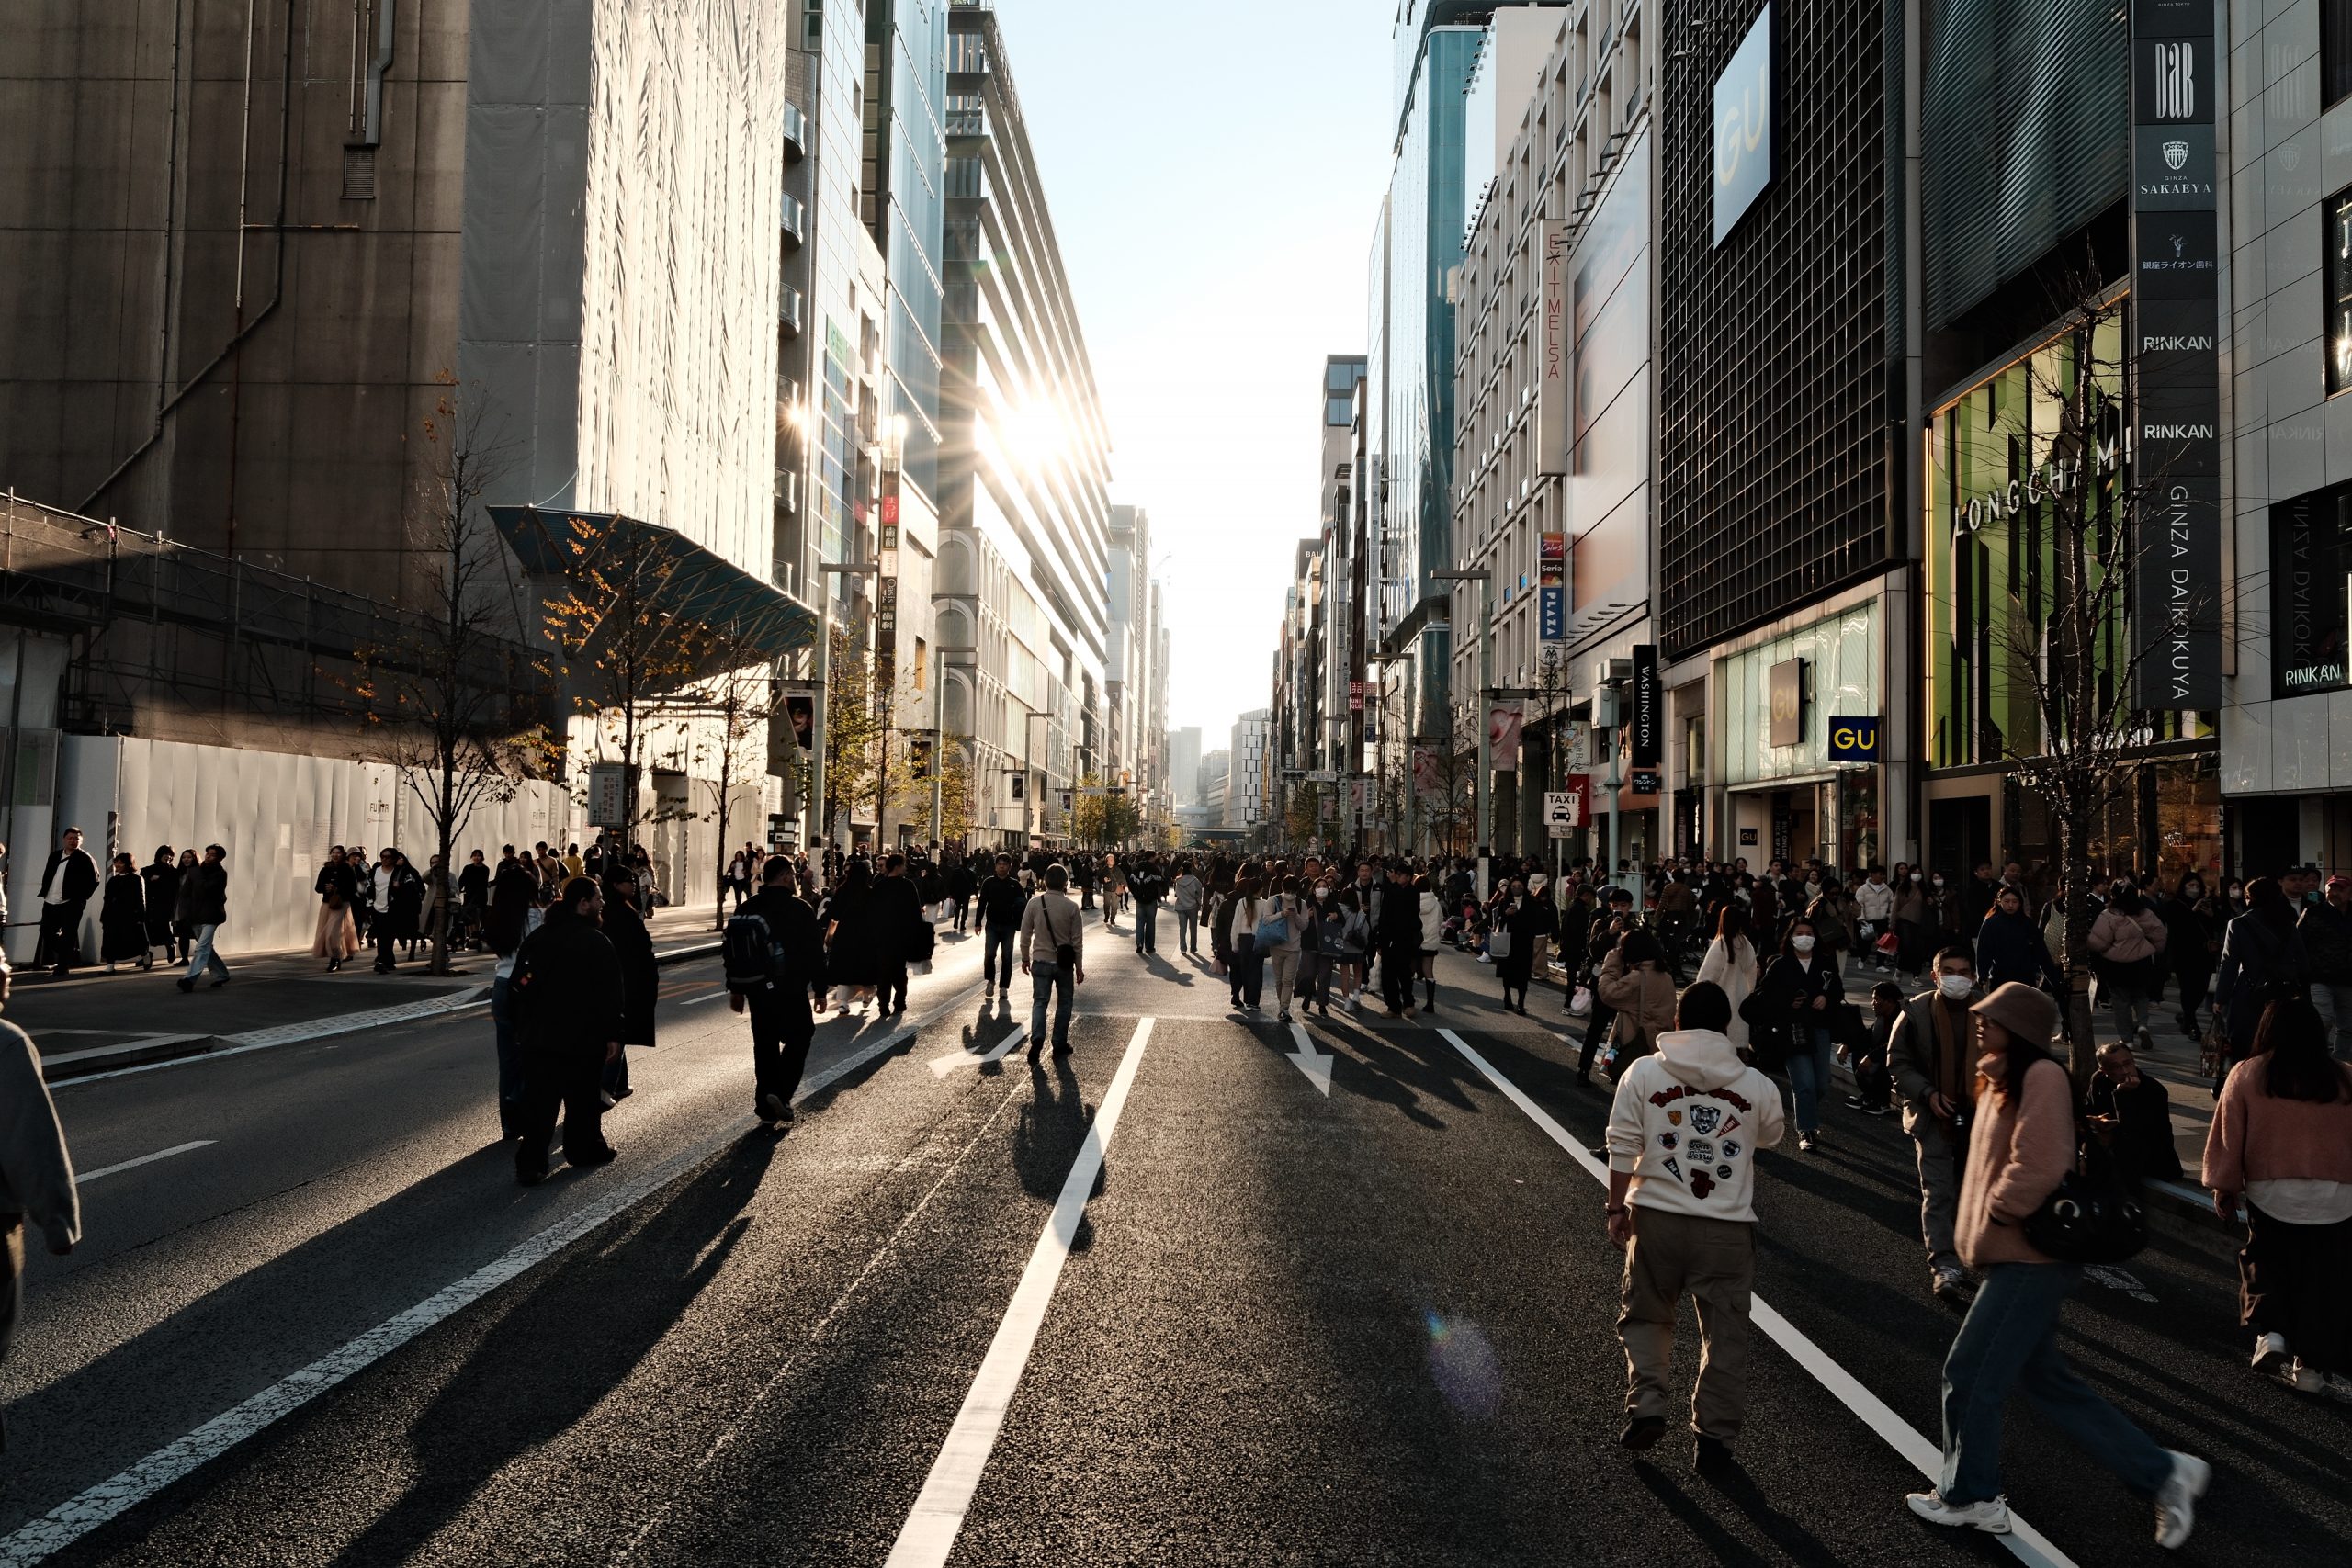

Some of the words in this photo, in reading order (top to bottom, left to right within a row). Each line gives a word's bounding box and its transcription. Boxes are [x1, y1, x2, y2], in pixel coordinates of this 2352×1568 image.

[1717, 63, 1766, 186] GU
[2140, 183, 2211, 195] SAKAEYA
[2142, 260, 2213, 270] 銀座ライオン歯科
[1547, 233, 1561, 379] EXITMELSA
[2143, 335, 2212, 352] RINKAN
[2143, 424, 2213, 439] RINKAN
[2170, 485, 2188, 558] GINZA
[1541, 564, 1563, 572] Seria
[887, 578, 897, 604] Oasis
[1546, 592, 1557, 636] PLAZA
[2170, 568, 2190, 700] DAIKOKUYA
[2285, 663, 2341, 687] RINKAN
[1641, 665, 1650, 749] WASHINGTON
[1772, 684, 1797, 723] GU
[1833, 728, 1875, 750] GU
[1548, 795, 1575, 804] TAXI
[1741, 832, 1757, 841] GU
